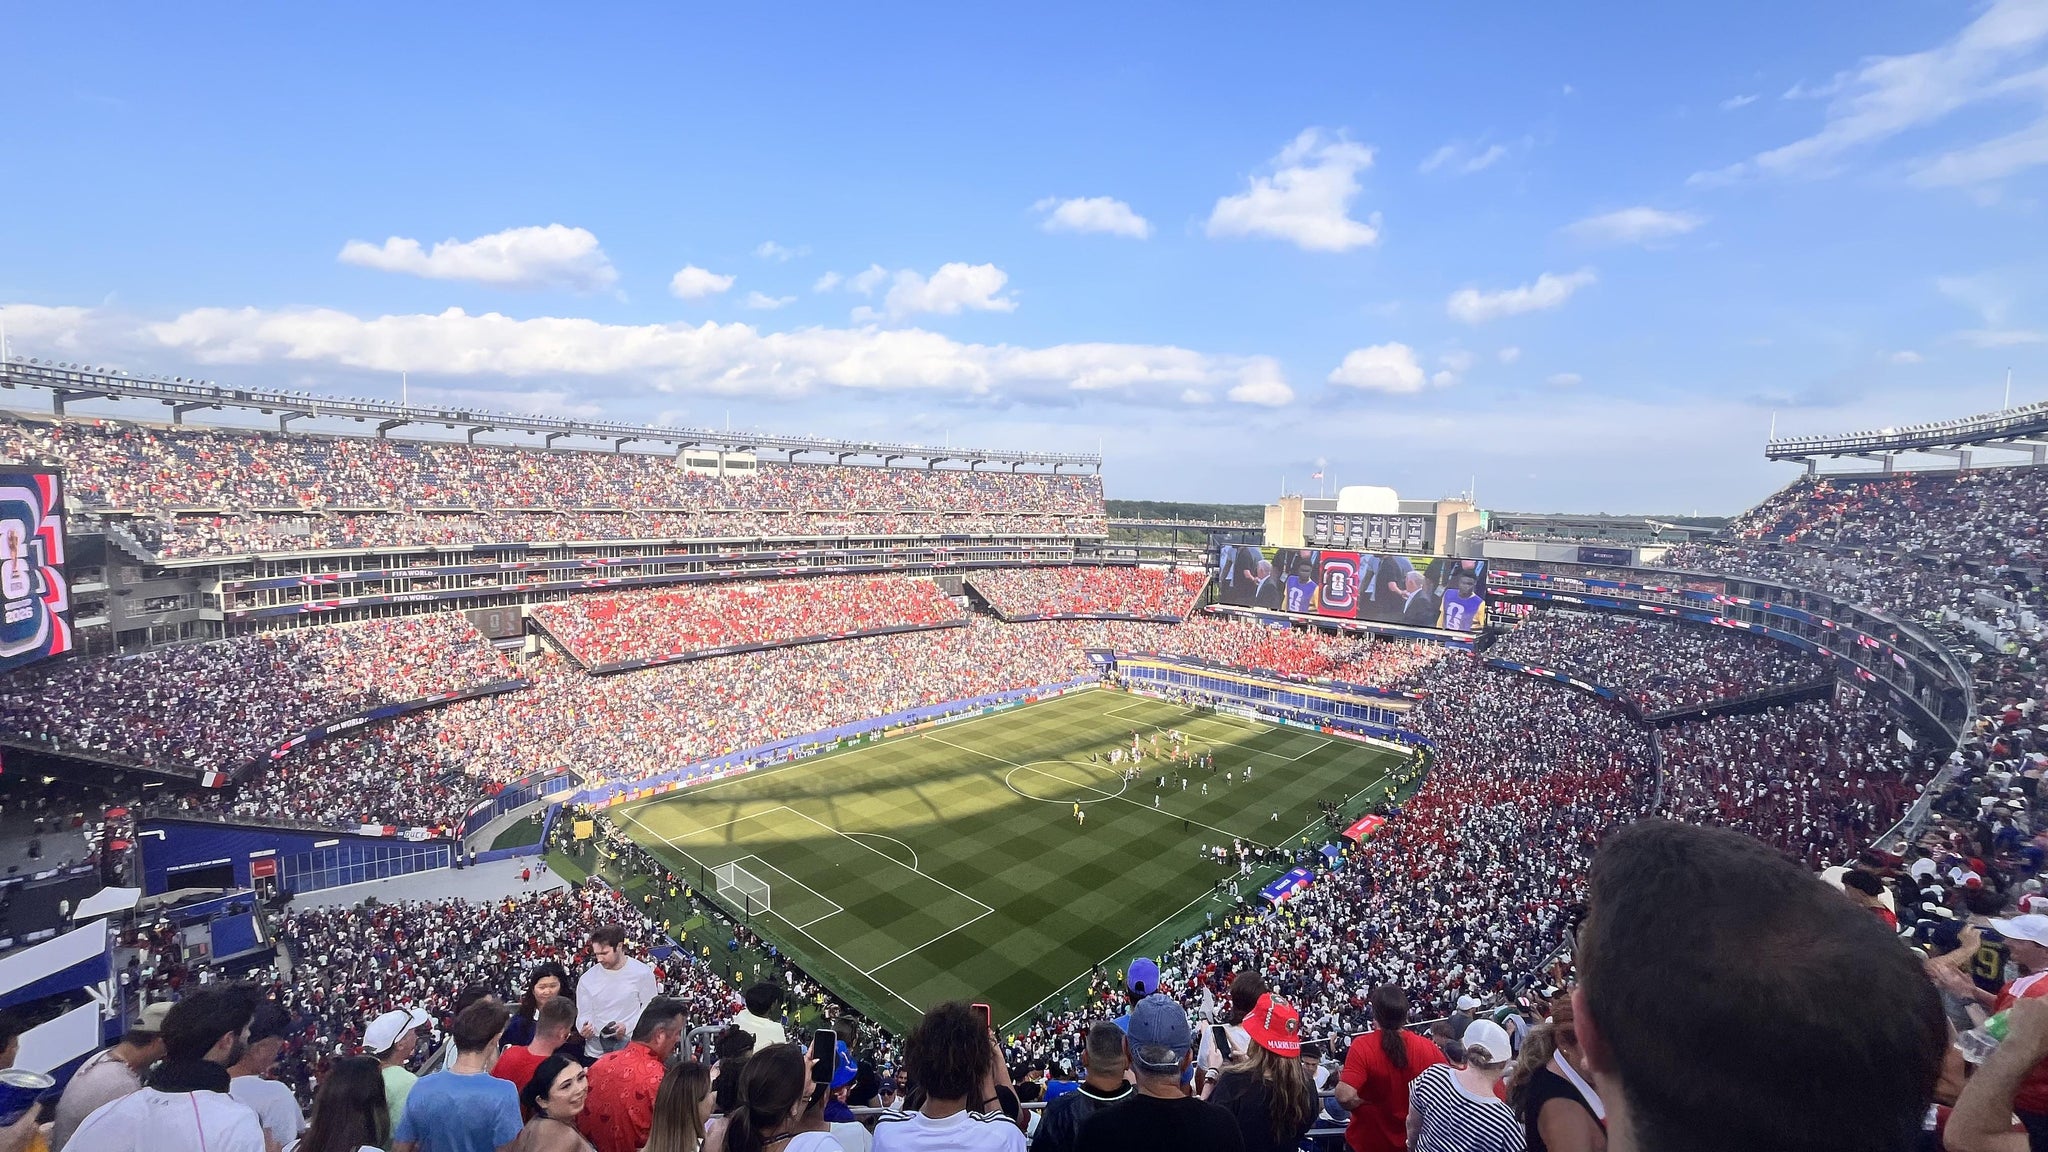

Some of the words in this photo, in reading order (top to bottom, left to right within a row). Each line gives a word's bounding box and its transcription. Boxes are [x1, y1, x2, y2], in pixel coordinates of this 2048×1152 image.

[326, 723, 341, 733] FIFA
[340, 717, 364, 729] WORLD
[794, 749, 817, 760] ULTRA
[686, 776, 713, 787] verizon
